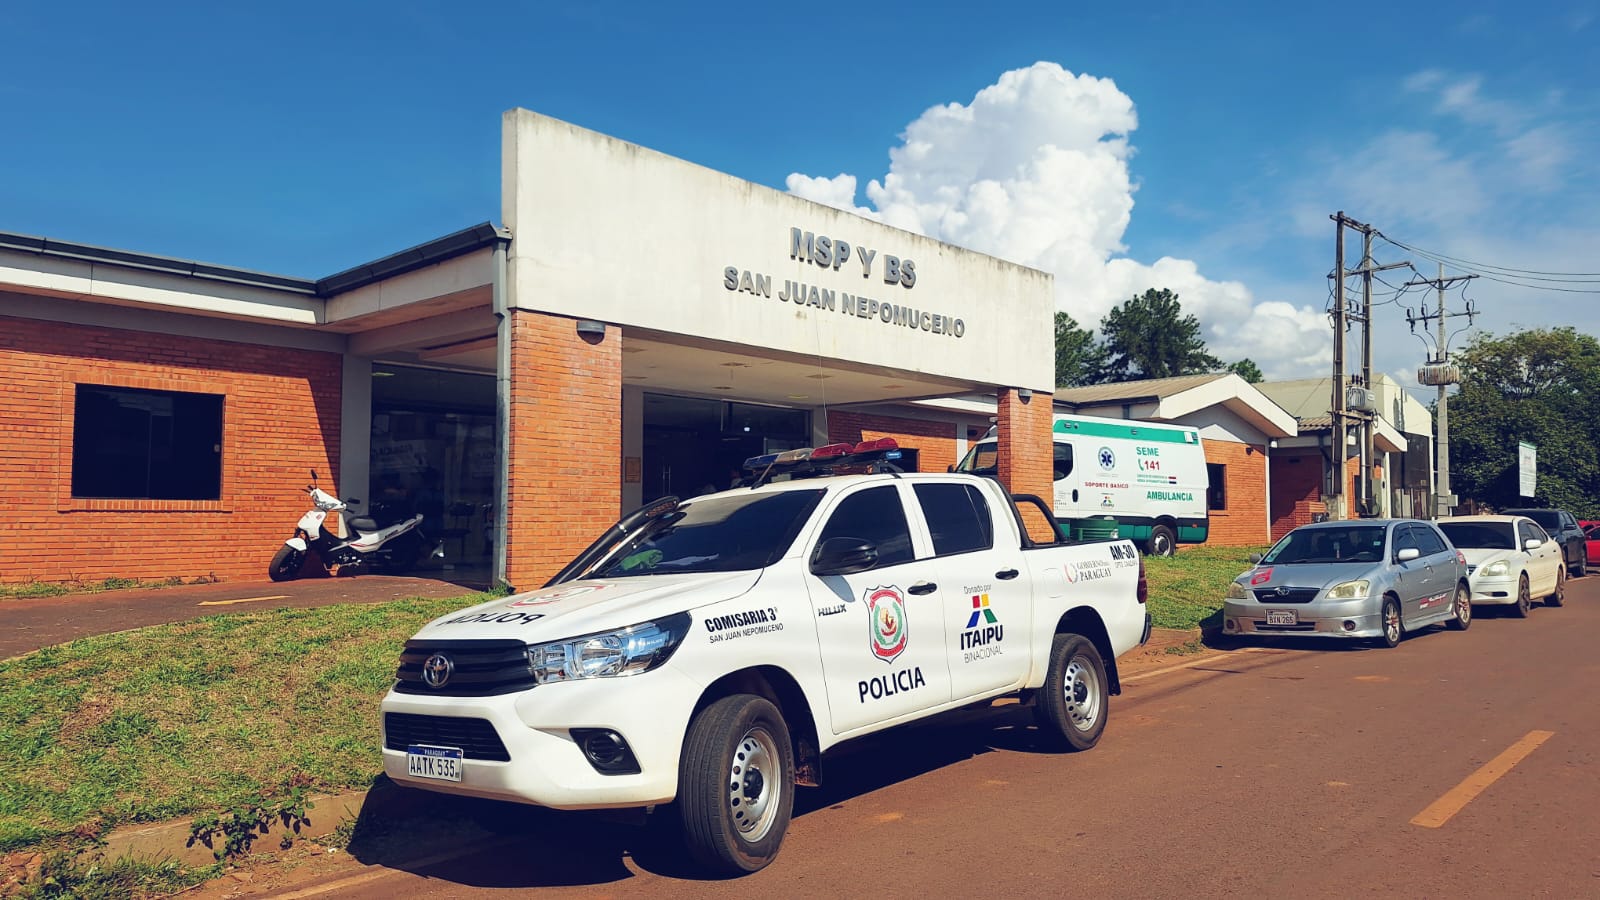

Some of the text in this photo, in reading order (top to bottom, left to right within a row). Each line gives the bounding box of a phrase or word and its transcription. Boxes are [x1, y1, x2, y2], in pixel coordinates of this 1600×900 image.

[790, 227, 916, 289] MSP Y BS
[724, 266, 965, 338] SAN JUAN NEPOMUCENO
[1136, 446, 1160, 457] SEME
[1144, 460, 1160, 471] 141
[1146, 491, 1193, 501] AMBULANCIA
[1109, 544, 1135, 561] AM-30
[1080, 568, 1112, 581] PARAGUAY
[964, 584, 992, 594] Donado por
[818, 604, 847, 616] HILUX
[704, 609, 769, 632] COMISARIA
[709, 622, 784, 643] SAN JUAN NEPOMUCENO
[960, 624, 1003, 650] ITAIPU
[964, 645, 1003, 664] BINACIONAL
[858, 666, 925, 703] POLICIA
[410, 756, 455, 777] AATK 535
